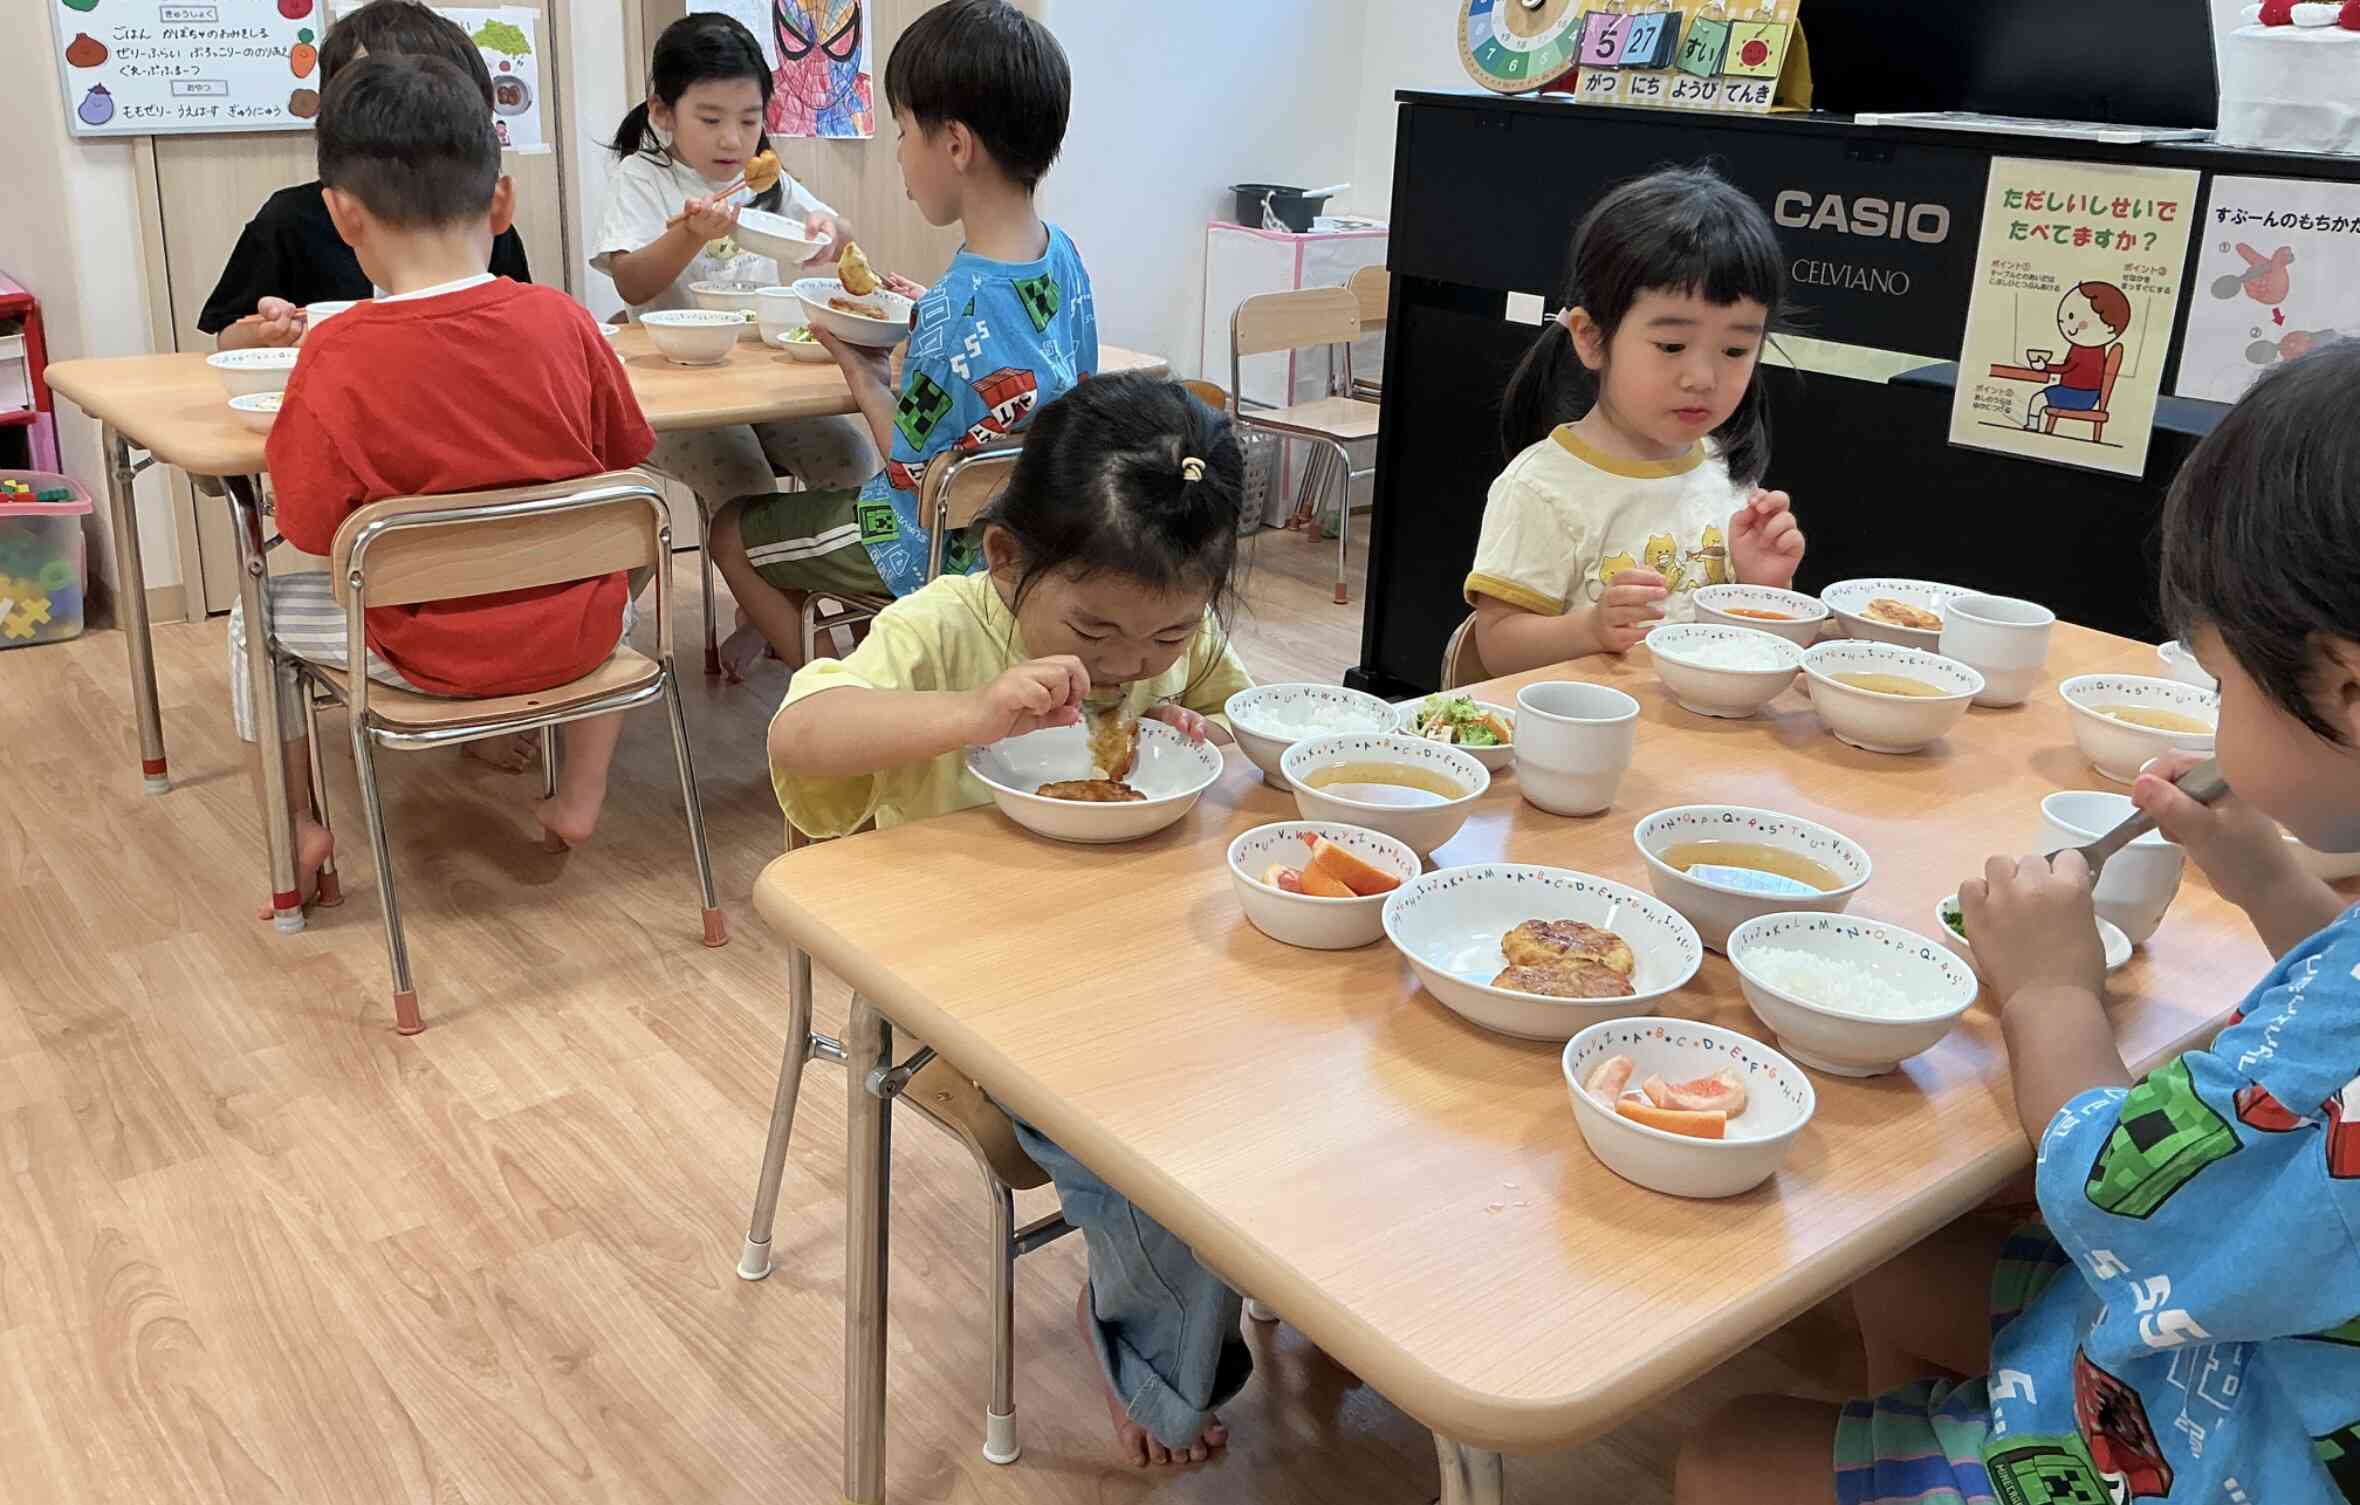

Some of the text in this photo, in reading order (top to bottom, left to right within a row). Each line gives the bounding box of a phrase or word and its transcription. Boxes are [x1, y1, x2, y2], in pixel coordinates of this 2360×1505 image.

[112, 26, 152, 40] ごはん
[1595, 30, 1618, 58] 5
[1628, 27, 1656, 54] 27
[1487, 47, 1496, 60] 7
[1687, 37, 1714, 61] すい
[1508, 59, 1519, 72] 6
[1585, 74, 1770, 103] がつ にち ようび てんき
[1774, 190, 1950, 243] CASIO
[2003, 188, 2177, 222] ただしいしせいで
[2008, 220, 2157, 251] たべてますか？
[1792, 258, 1910, 296] CELVIANO
